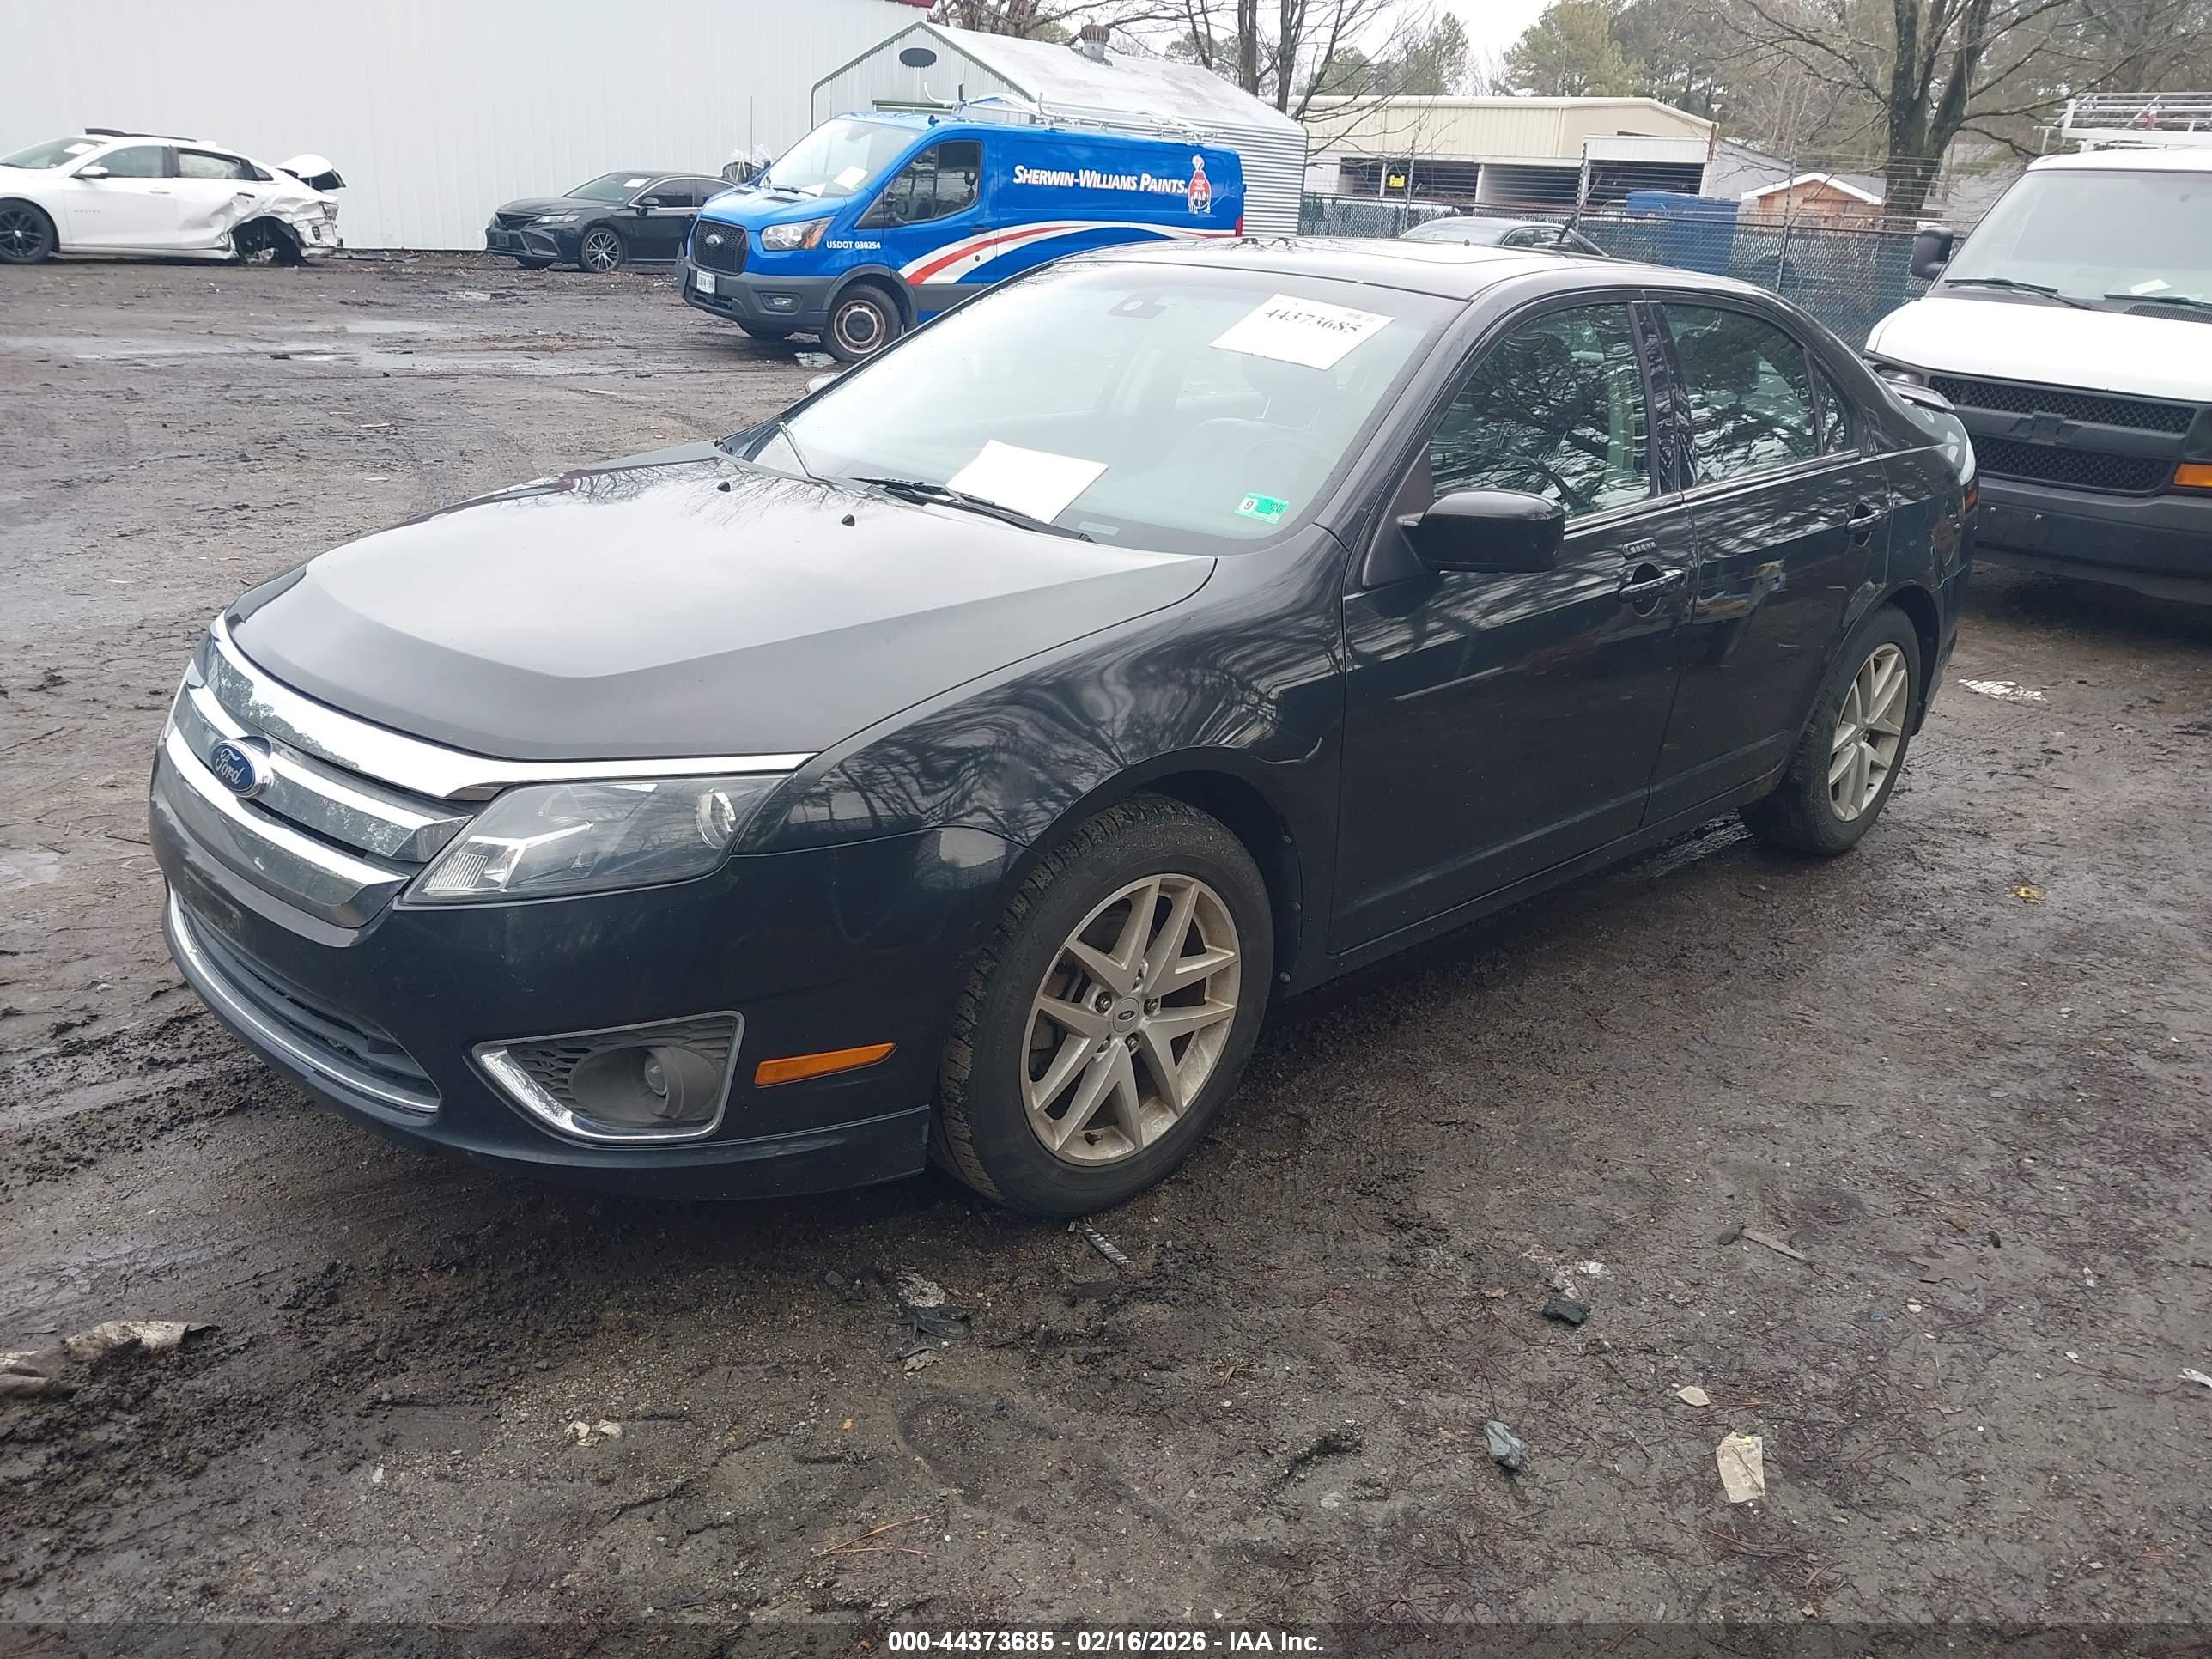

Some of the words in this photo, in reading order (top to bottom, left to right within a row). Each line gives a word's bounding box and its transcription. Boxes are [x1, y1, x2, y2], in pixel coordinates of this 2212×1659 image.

[1013, 165, 1138, 191] SHERWIN-WILLIAMS
[826, 240, 853, 249] USDOT
[854, 241, 881, 250] 030254
[1265, 308, 1363, 333] 44373685
[1244, 501, 1254, 510] 9
[215, 748, 245, 785] Ford
